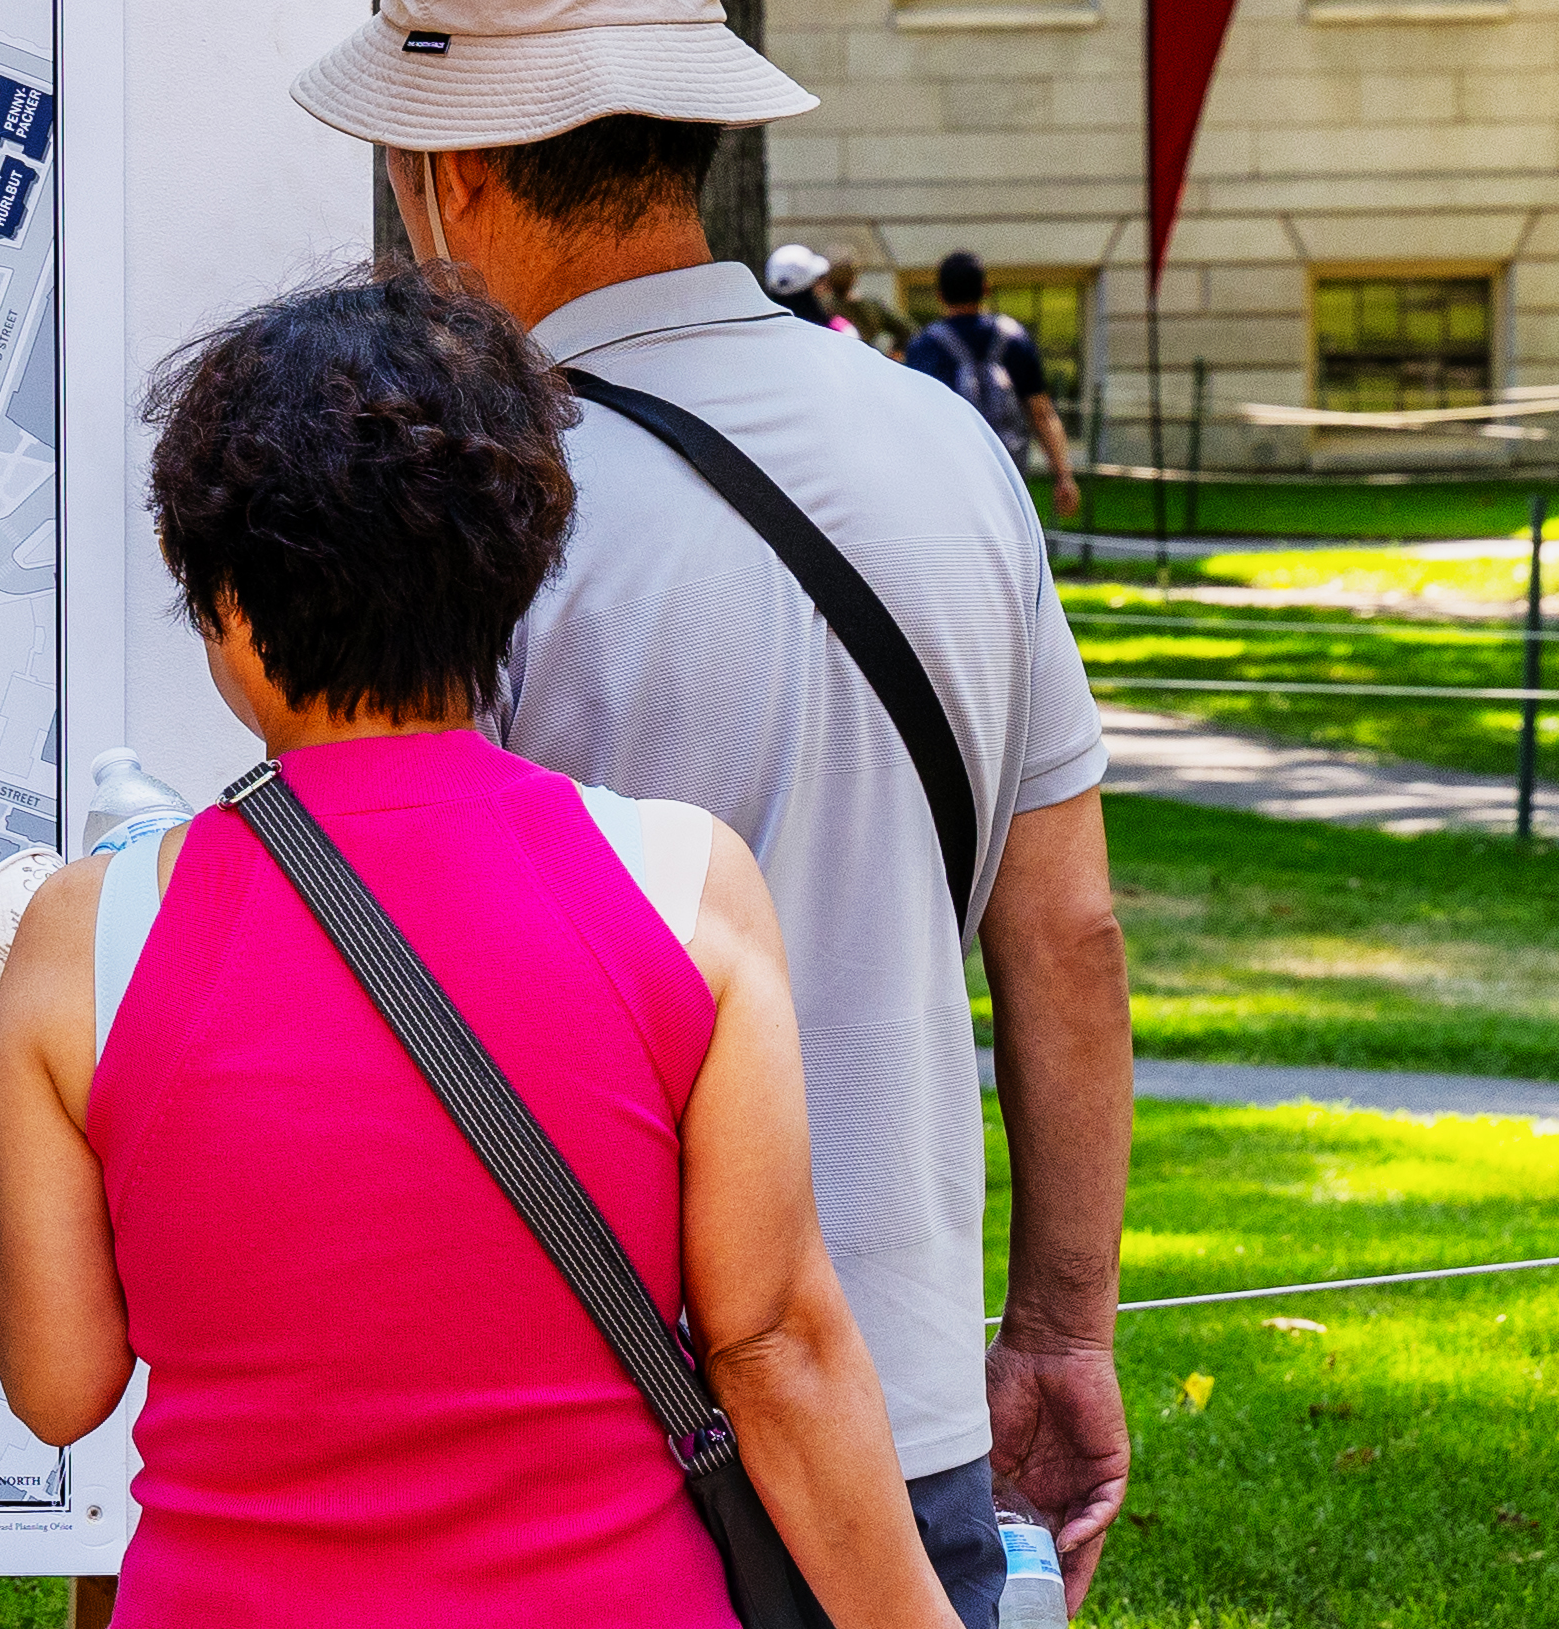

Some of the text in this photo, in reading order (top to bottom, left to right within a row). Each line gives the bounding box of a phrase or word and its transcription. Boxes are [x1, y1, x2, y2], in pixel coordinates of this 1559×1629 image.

[4, 87, 26, 132] PENNY-
[16, 89, 42, 138] PACKER
[0, 786, 41, 808] STREET
